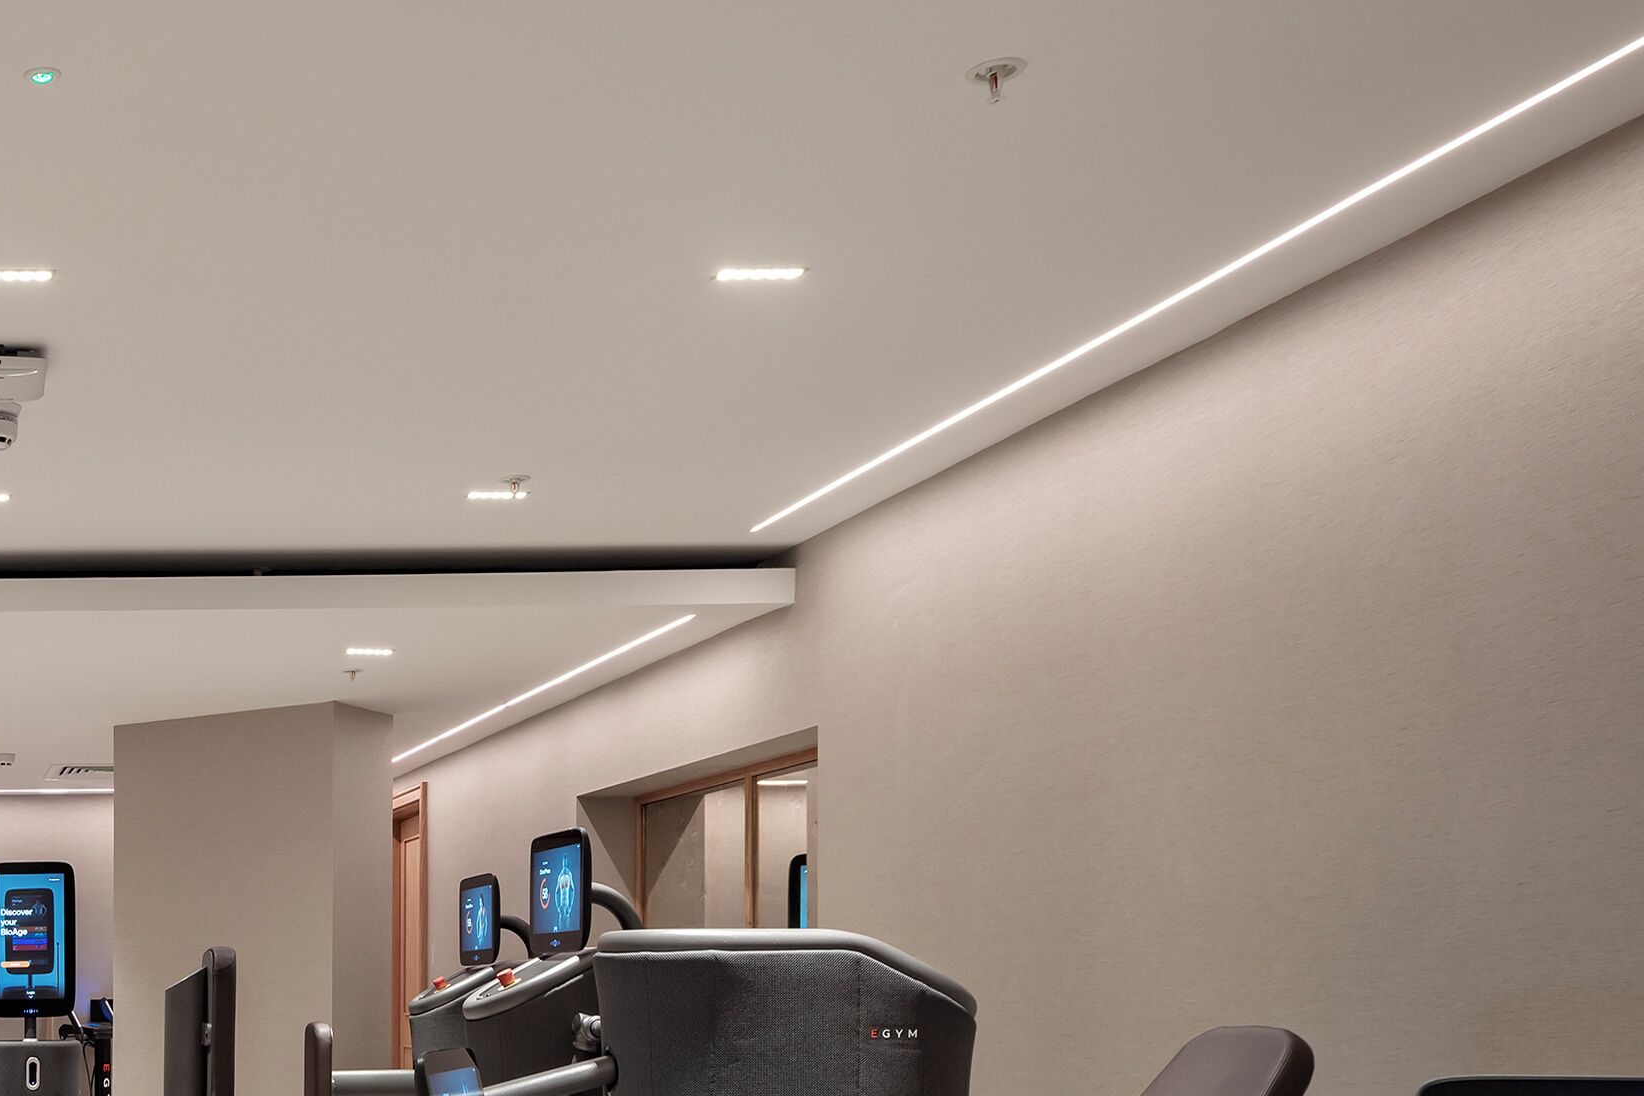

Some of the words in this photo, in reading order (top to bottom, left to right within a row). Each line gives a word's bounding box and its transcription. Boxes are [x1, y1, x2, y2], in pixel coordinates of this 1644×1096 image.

[0, 908, 34, 916] Discover
[0, 919, 18, 927] your
[0, 928, 28, 937] BioAge
[870, 1028, 918, 1039] EGYM
